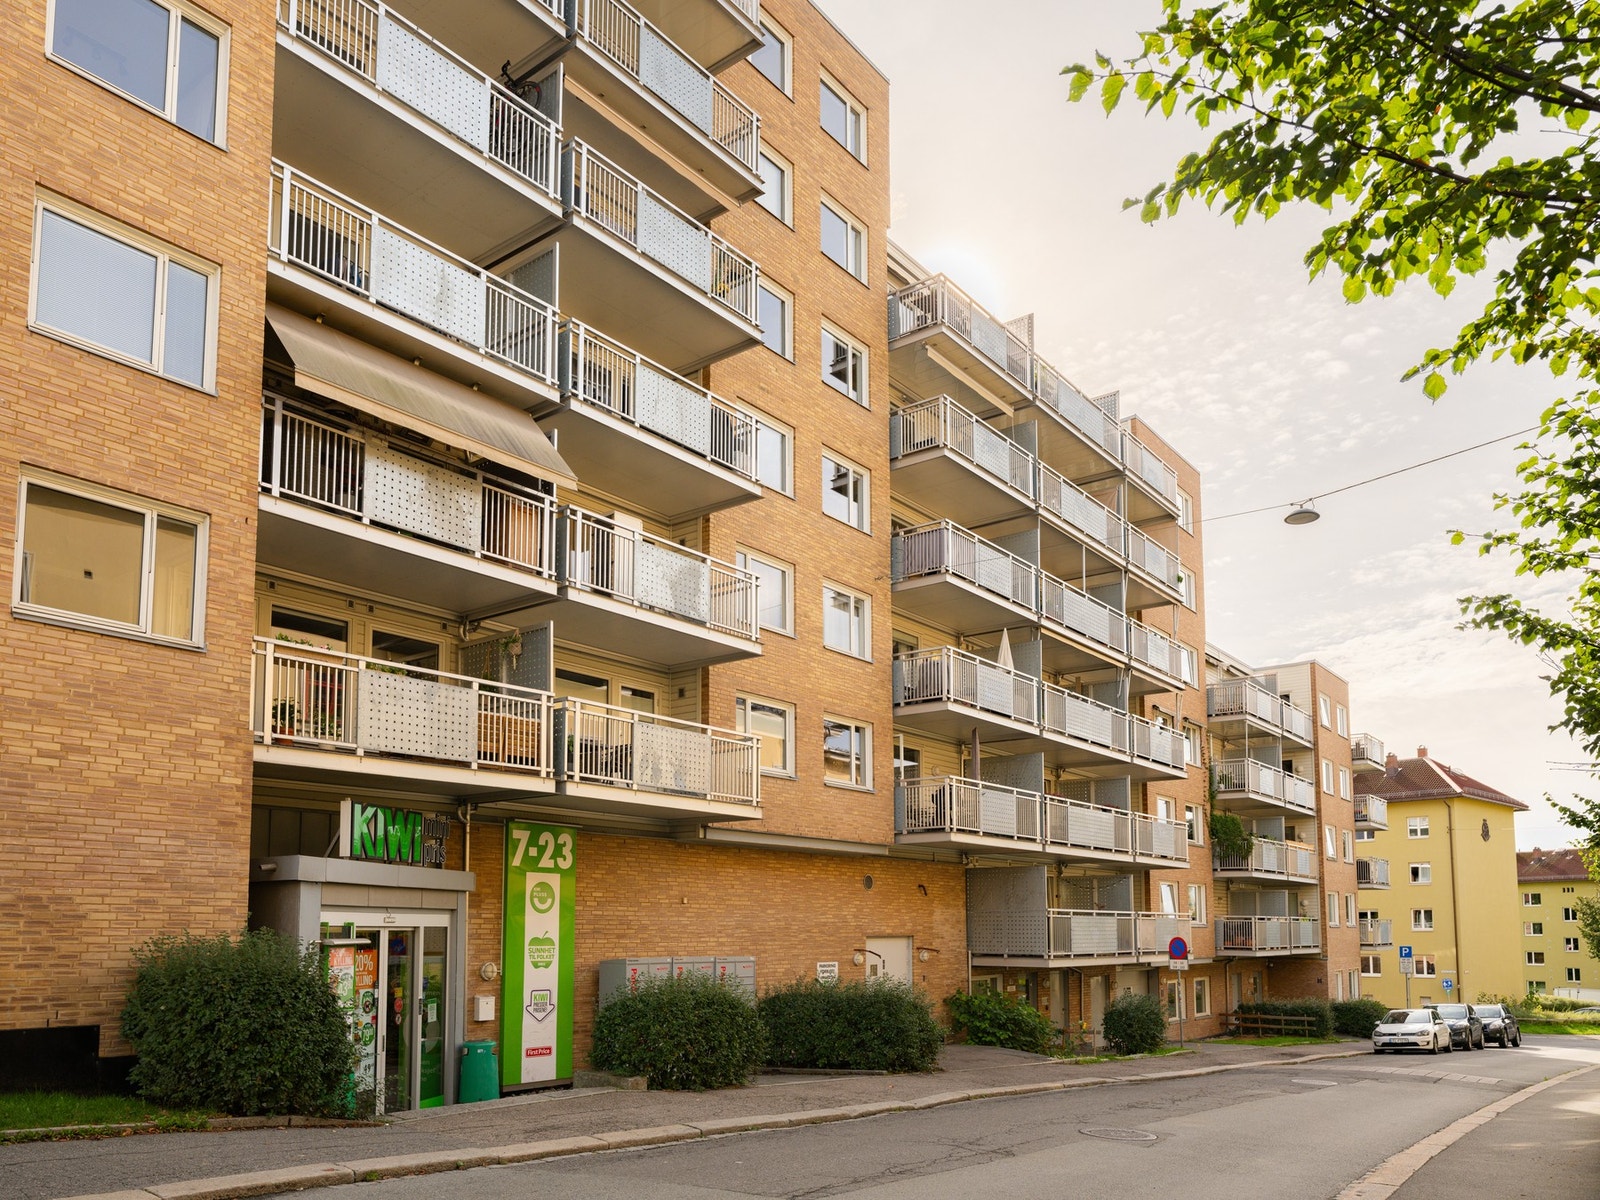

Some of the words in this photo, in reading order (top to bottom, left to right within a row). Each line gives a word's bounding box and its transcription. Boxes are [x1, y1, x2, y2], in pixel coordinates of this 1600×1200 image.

[352, 802, 422, 863] KIWI
[423, 813, 450, 839] mini
[423, 840, 447, 867] pris
[512, 829, 573, 870] 7-23
[1402, 947, 1410, 957] P
[533, 993, 548, 1002] KIWI
